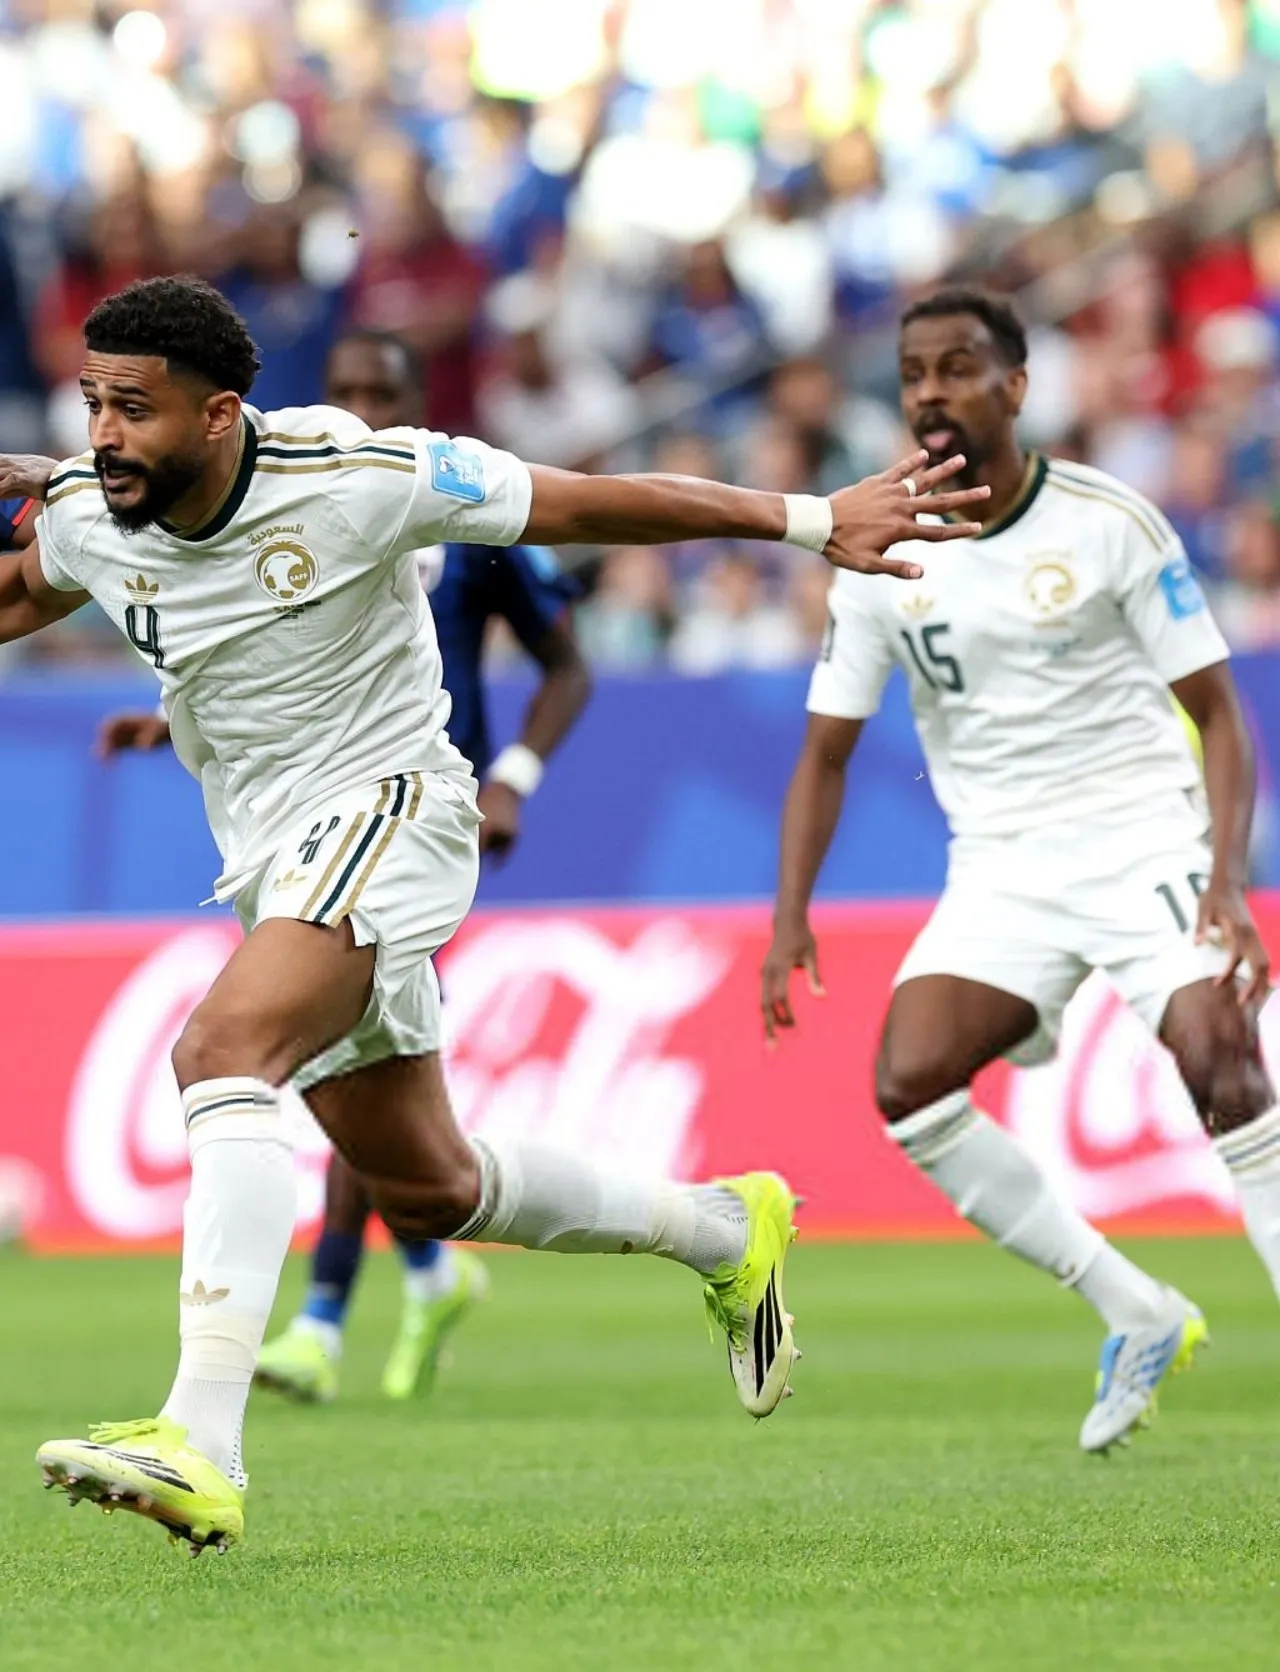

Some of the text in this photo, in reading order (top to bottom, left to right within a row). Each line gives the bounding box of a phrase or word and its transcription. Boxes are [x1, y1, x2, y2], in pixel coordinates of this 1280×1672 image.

[247, 523, 305, 546] السعودية
[289, 571, 309, 582] SAFF
[124, 604, 165, 669] 4
[900, 623, 965, 693] 15
